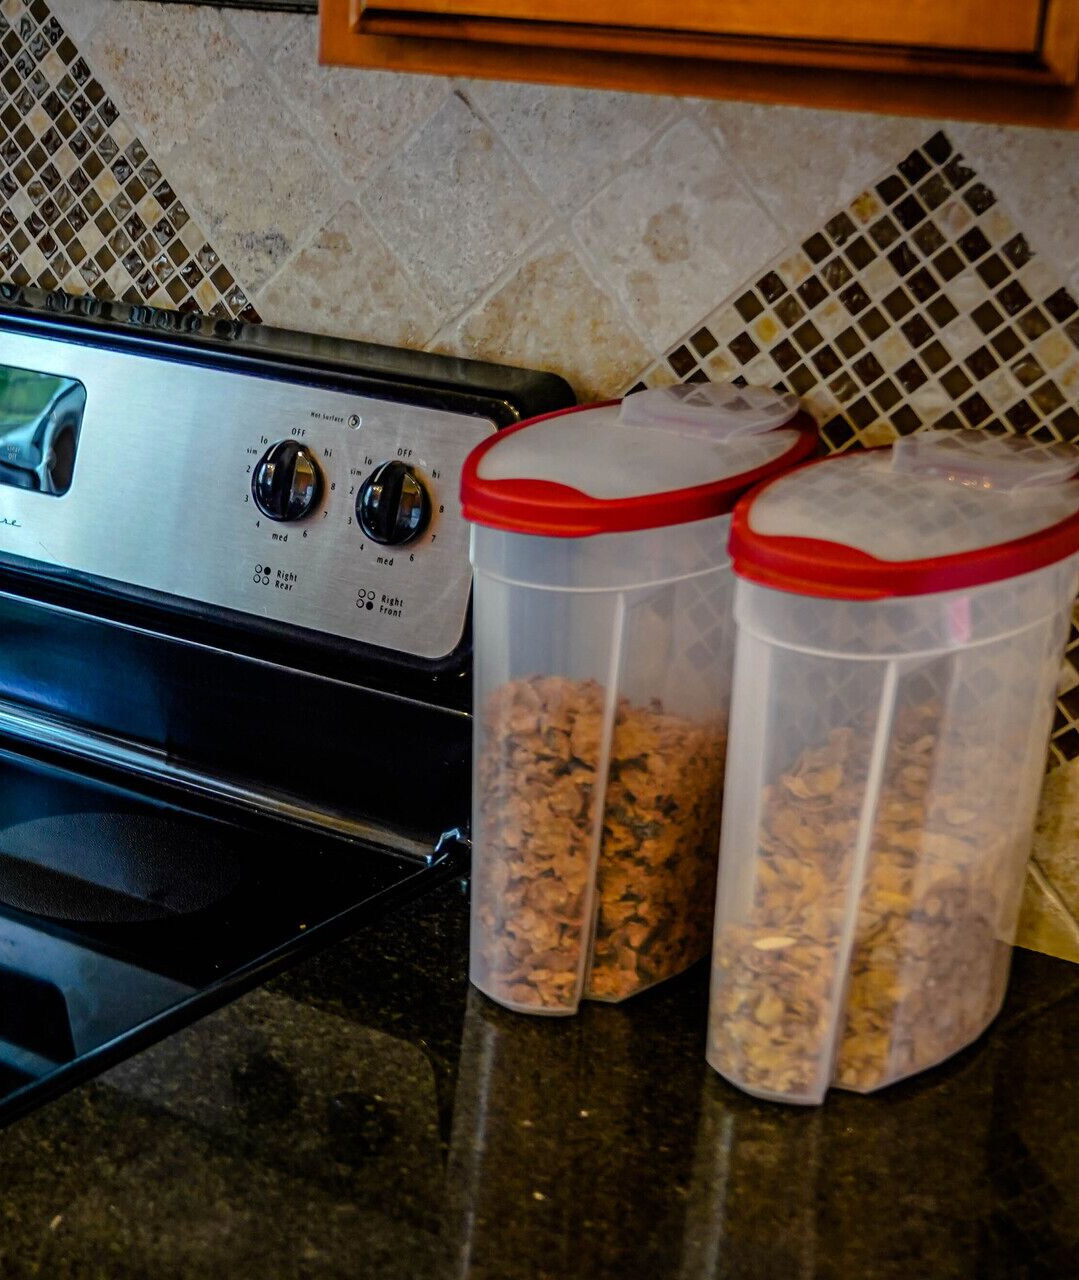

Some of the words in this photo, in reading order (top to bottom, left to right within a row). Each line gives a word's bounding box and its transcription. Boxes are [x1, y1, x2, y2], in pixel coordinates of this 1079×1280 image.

[291, 428, 306, 437] OFF
[260, 436, 268, 444] lo
[324, 448, 333, 457] hi
[397, 448, 413, 458] OFF
[364, 456, 373, 465] lo
[246, 465, 251, 473] 2
[350, 468, 362, 476] sim
[432, 469, 440, 478] hi
[350, 486, 354, 494] 2
[323, 511, 328, 519] 7
[272, 532, 288, 542] med
[303, 530, 308, 538] 6
[432, 535, 436, 543] 7
[377, 556, 394, 566] med
[277, 570, 298, 582] Right
[274, 580, 293, 591] Rear
[381, 595, 403, 607] Right
[380, 605, 402, 617] Front
